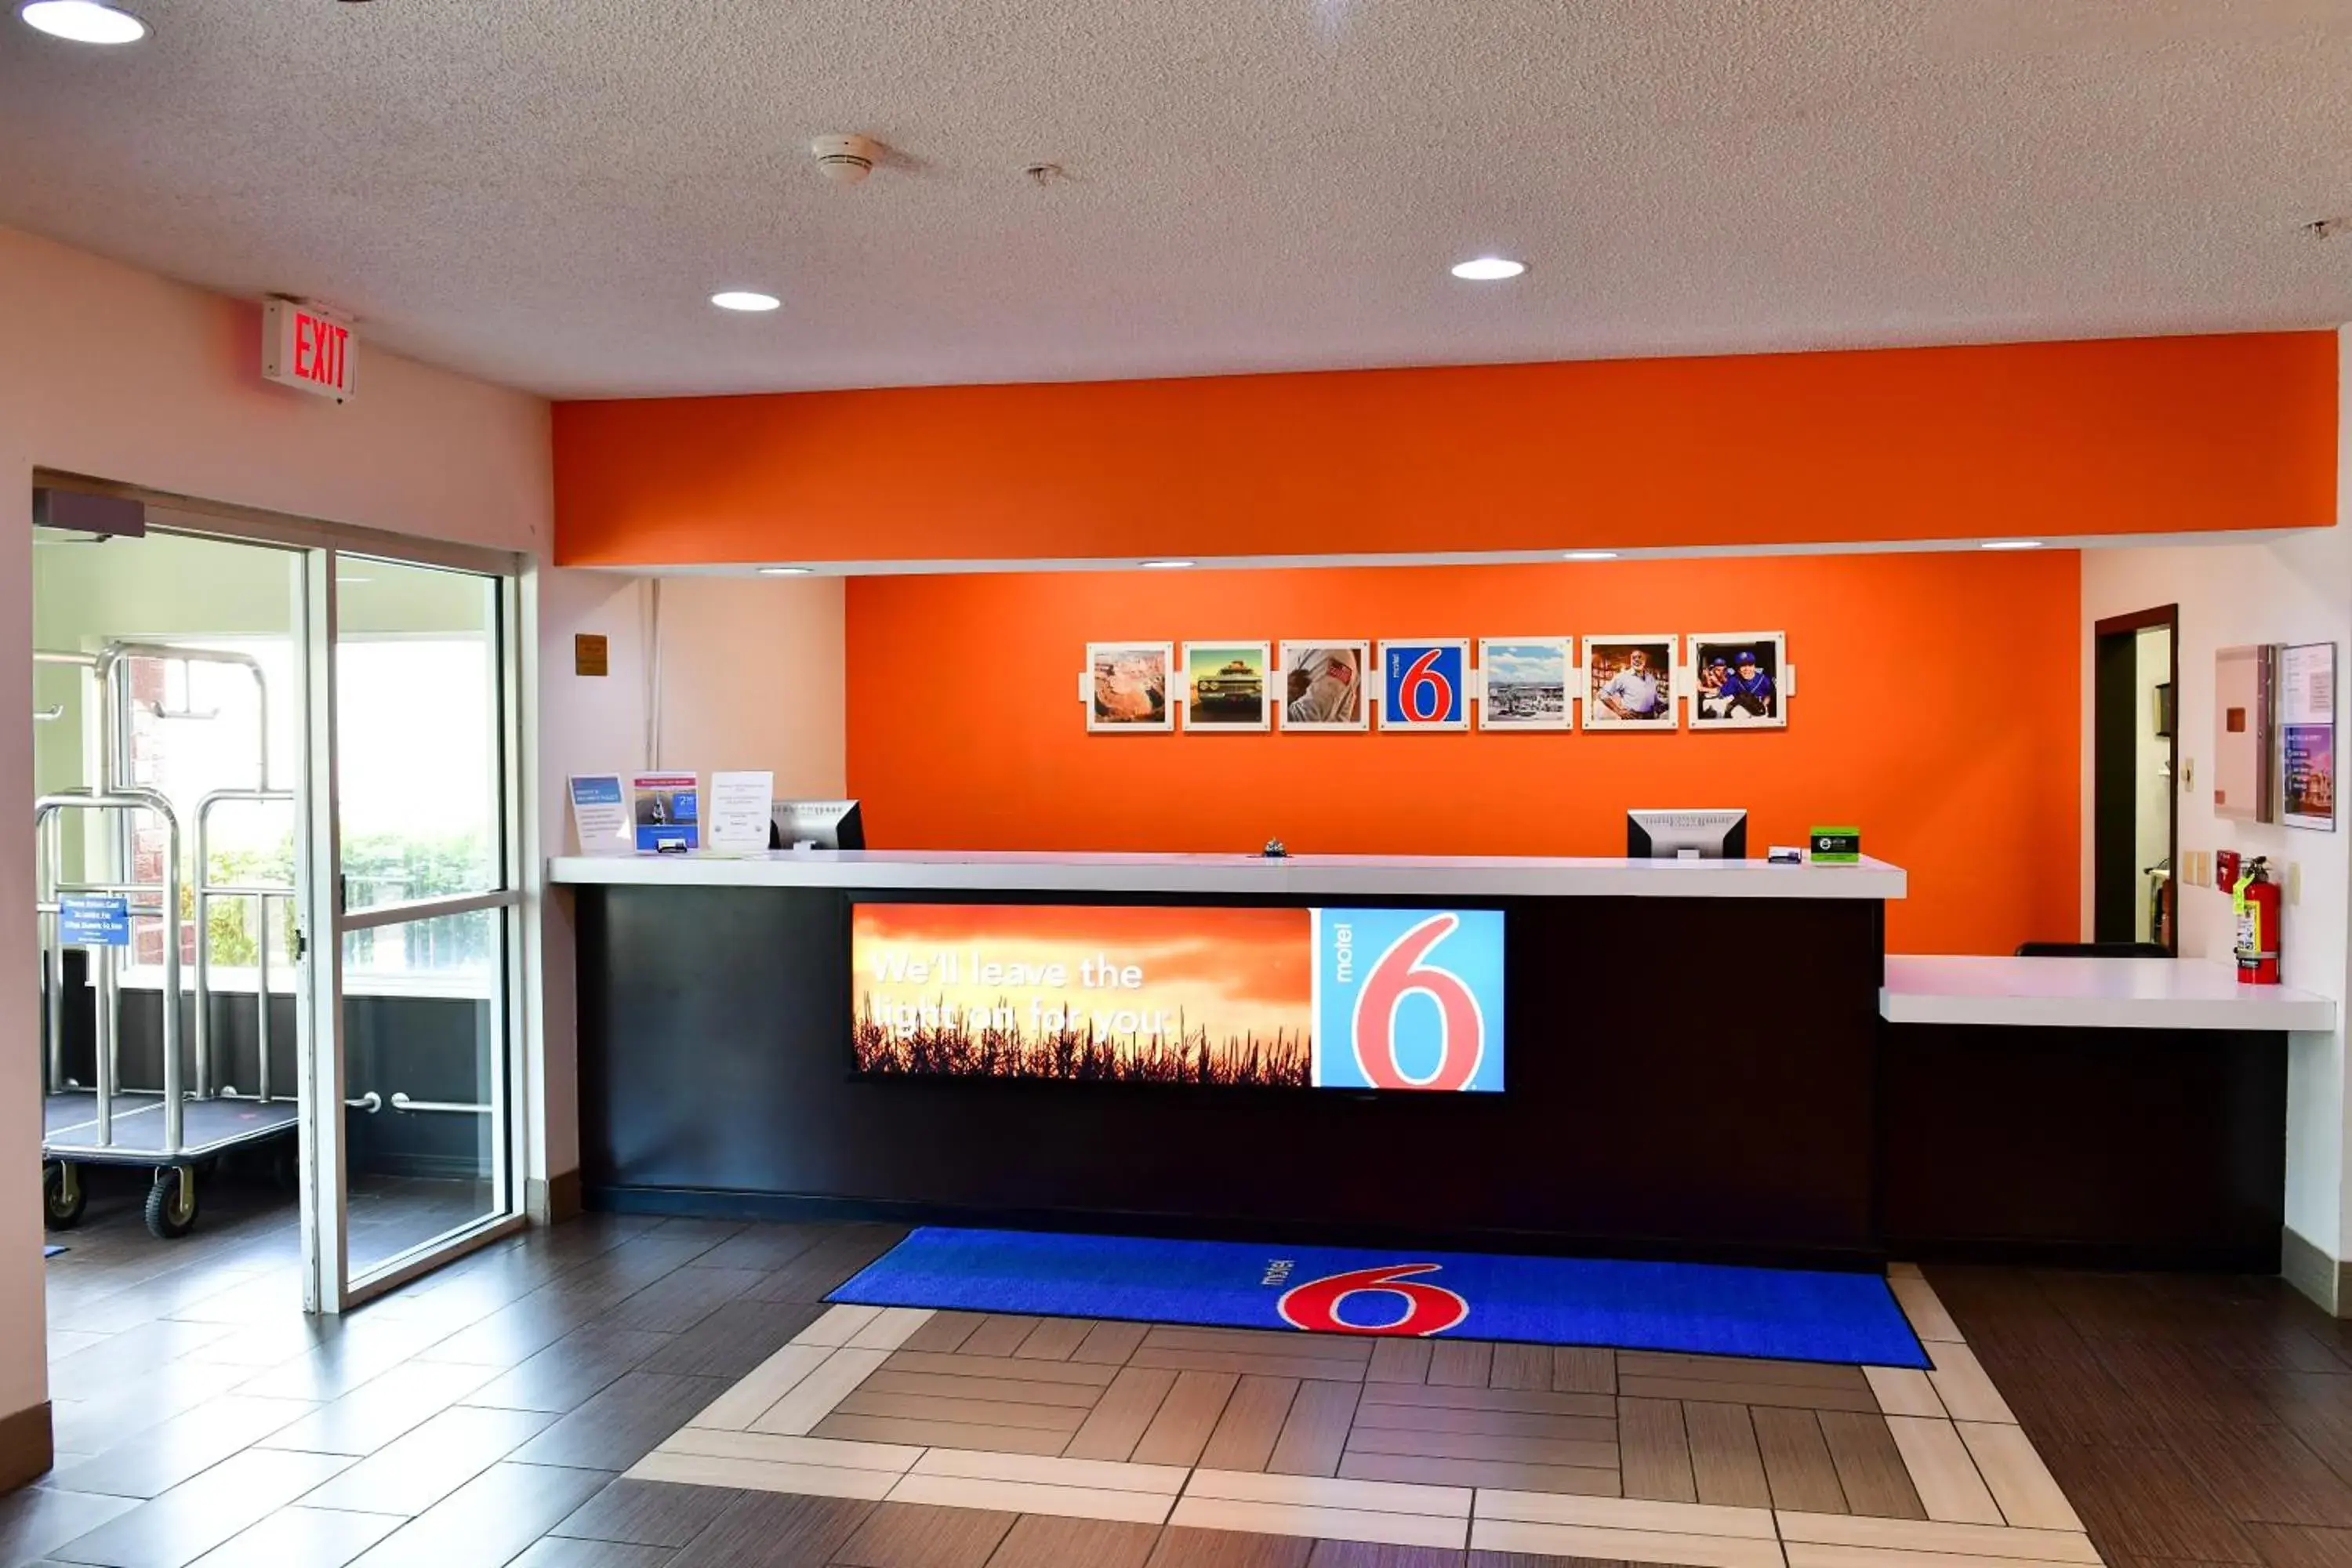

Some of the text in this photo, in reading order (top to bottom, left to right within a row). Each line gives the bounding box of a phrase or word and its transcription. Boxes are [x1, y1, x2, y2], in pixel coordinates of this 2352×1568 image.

[295, 312, 348, 390] EXIT
[1399, 648, 1452, 721] 6
[871, 952, 1144, 989] We'll leave the
[1334, 913, 1484, 1091] motel 6
[873, 994, 957, 1038] light
[968, 1005, 1014, 1032] on
[1030, 997, 1082, 1033] for
[1276, 1263, 1470, 1336] 6
